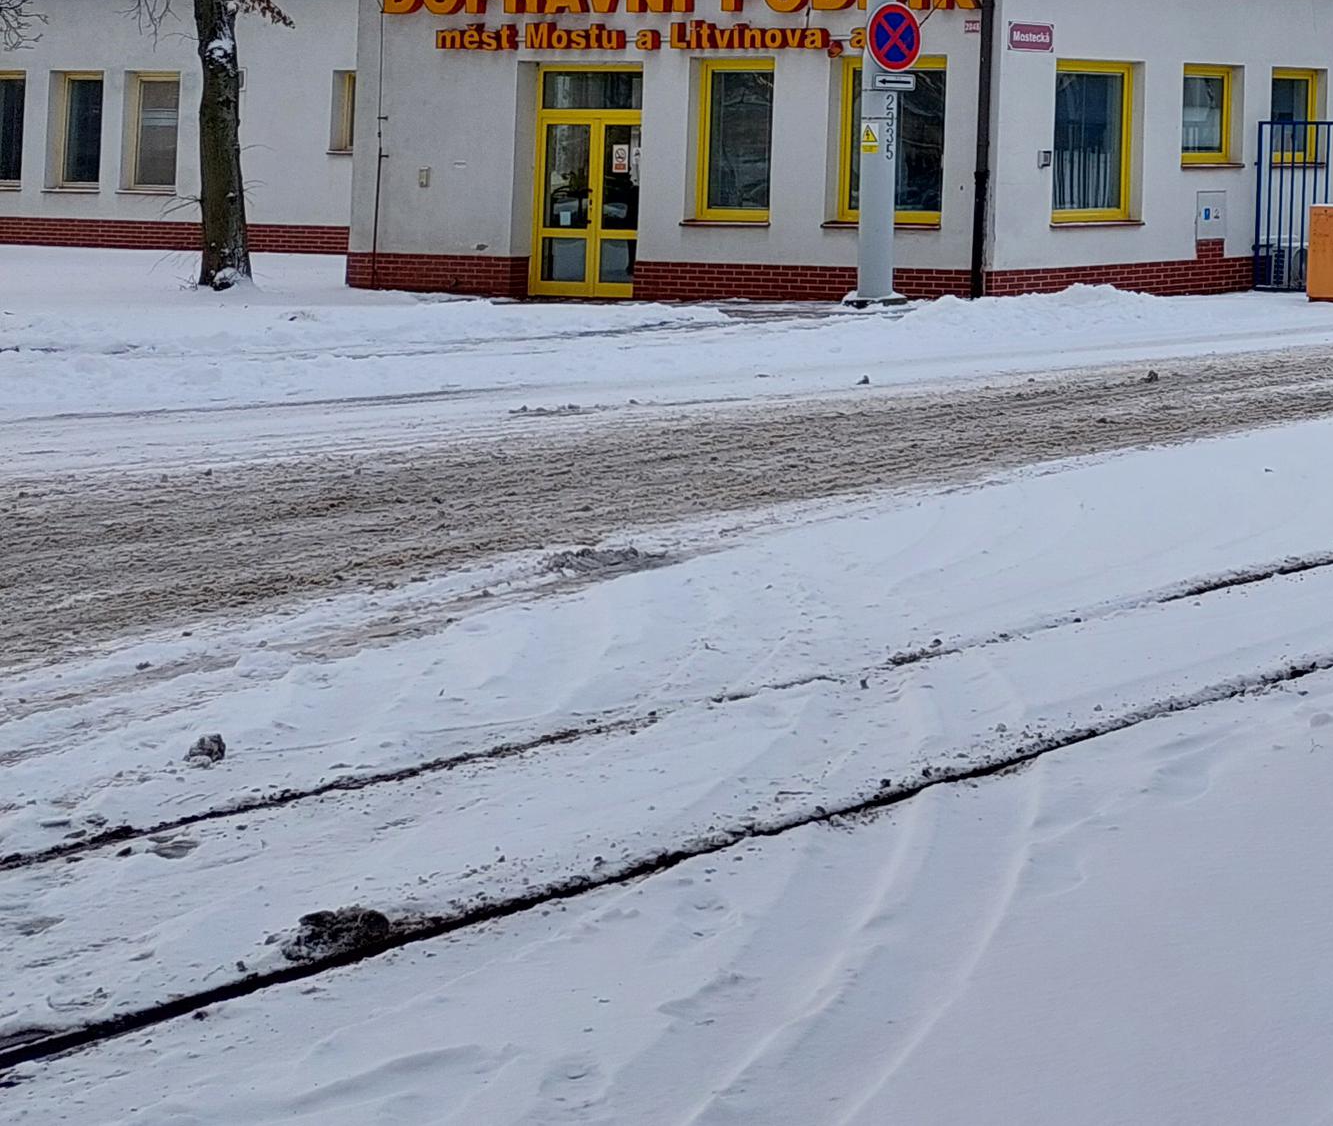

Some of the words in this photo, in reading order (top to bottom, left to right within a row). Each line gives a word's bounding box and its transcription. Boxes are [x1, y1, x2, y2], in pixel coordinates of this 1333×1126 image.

[435, 23, 517, 51] měst
[525, 22, 626, 51] Mostu
[635, 29, 661, 50] a
[1012, 30, 1051, 43] Mostecká
